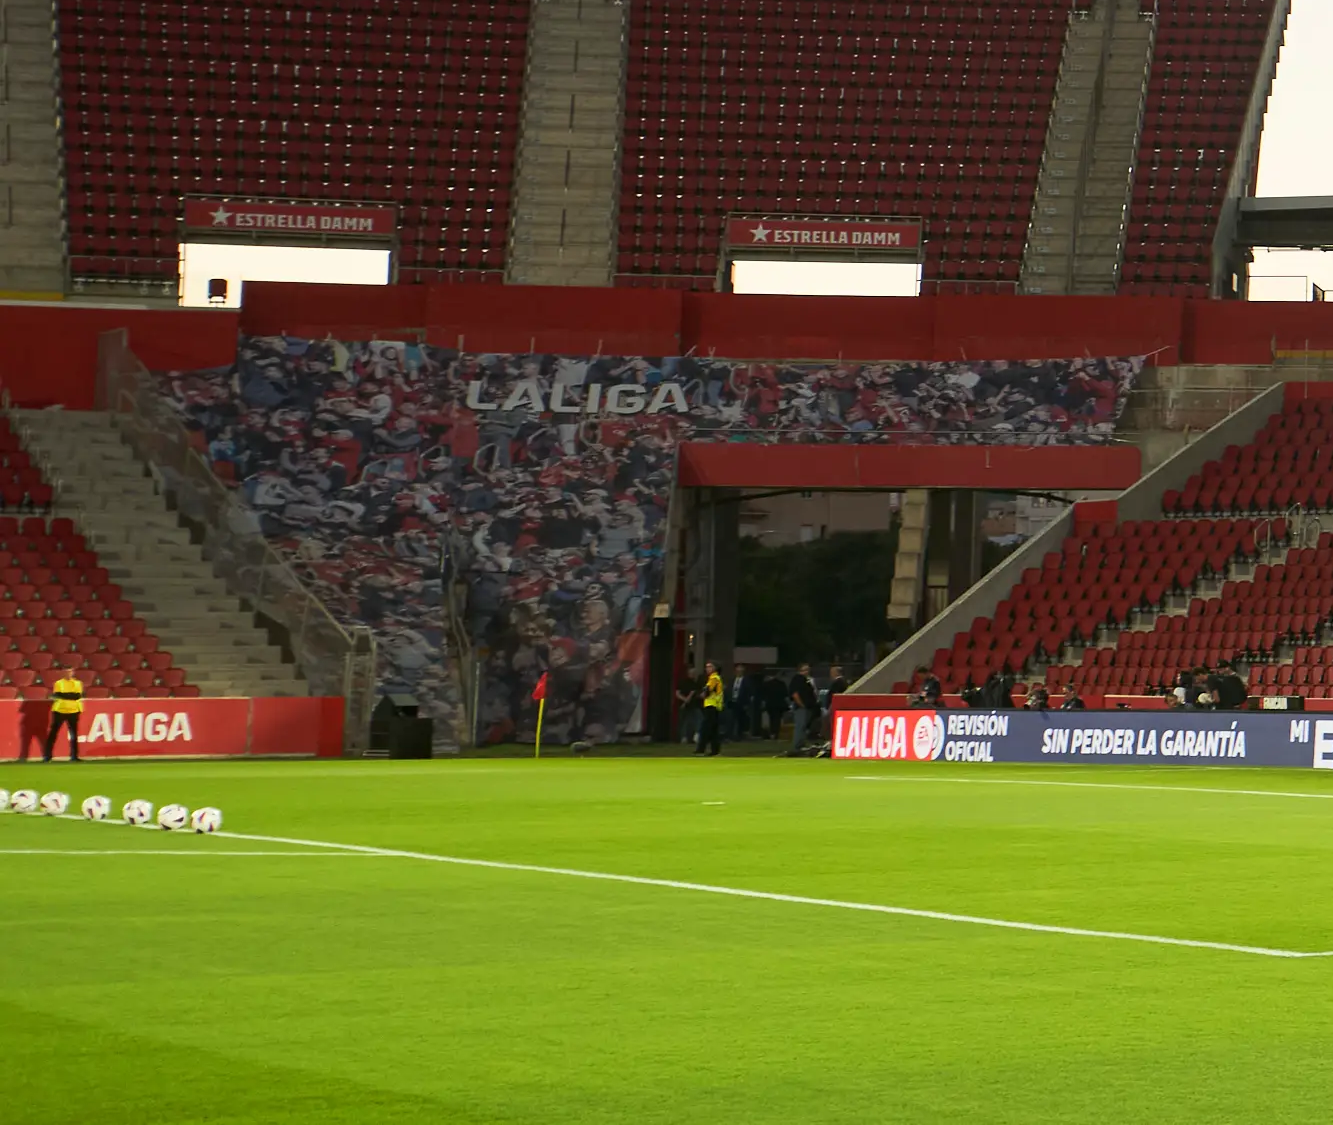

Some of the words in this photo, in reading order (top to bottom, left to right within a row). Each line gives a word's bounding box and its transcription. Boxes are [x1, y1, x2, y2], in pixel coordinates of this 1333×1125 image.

[235, 213, 317, 229] ESTRELLA
[320, 216, 373, 231] DAMM
[773, 229, 848, 244] ESTRELLA
[851, 231, 901, 245] DAMM
[466, 380, 690, 413] LALIGA
[947, 710, 1009, 736] REVISIÓN
[1290, 720, 1310, 742] MI
[834, 716, 907, 758] LALIGA
[1041, 728, 1070, 754] SIN
[1070, 728, 1135, 755] PERDER
[1136, 729, 1157, 755] LA
[1160, 721, 1246, 757] GARANTÍA
[945, 741, 994, 762] OFICIAL
